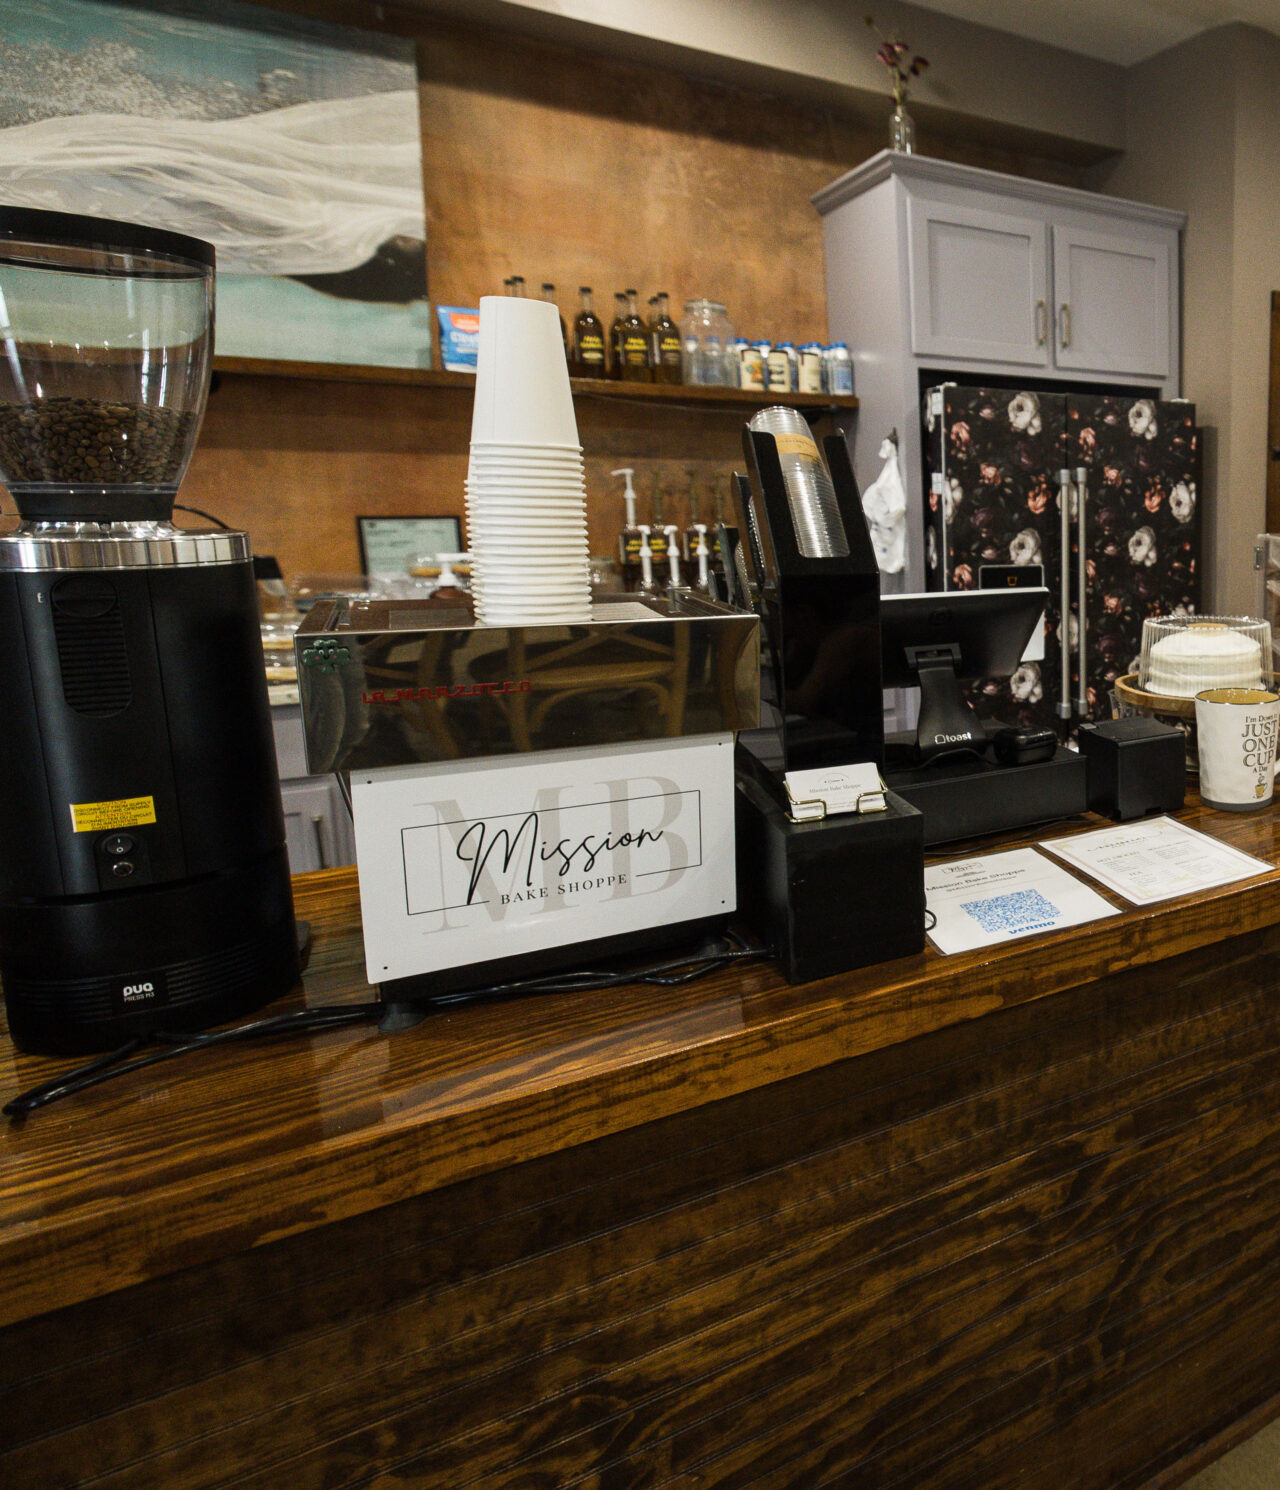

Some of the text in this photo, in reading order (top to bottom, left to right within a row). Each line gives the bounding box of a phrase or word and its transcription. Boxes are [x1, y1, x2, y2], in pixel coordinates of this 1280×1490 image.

[1245, 715, 1257, 723] I'm
[946, 732, 972, 742] toast
[1241, 720, 1278, 738] JUST
[1242, 735, 1276, 753] ONE
[1242, 749, 1275, 768] CUP
[456, 812, 664, 906] Mission
[500, 873, 629, 905] BAKE SHOPPE
[1008, 920, 1056, 935] venmo
